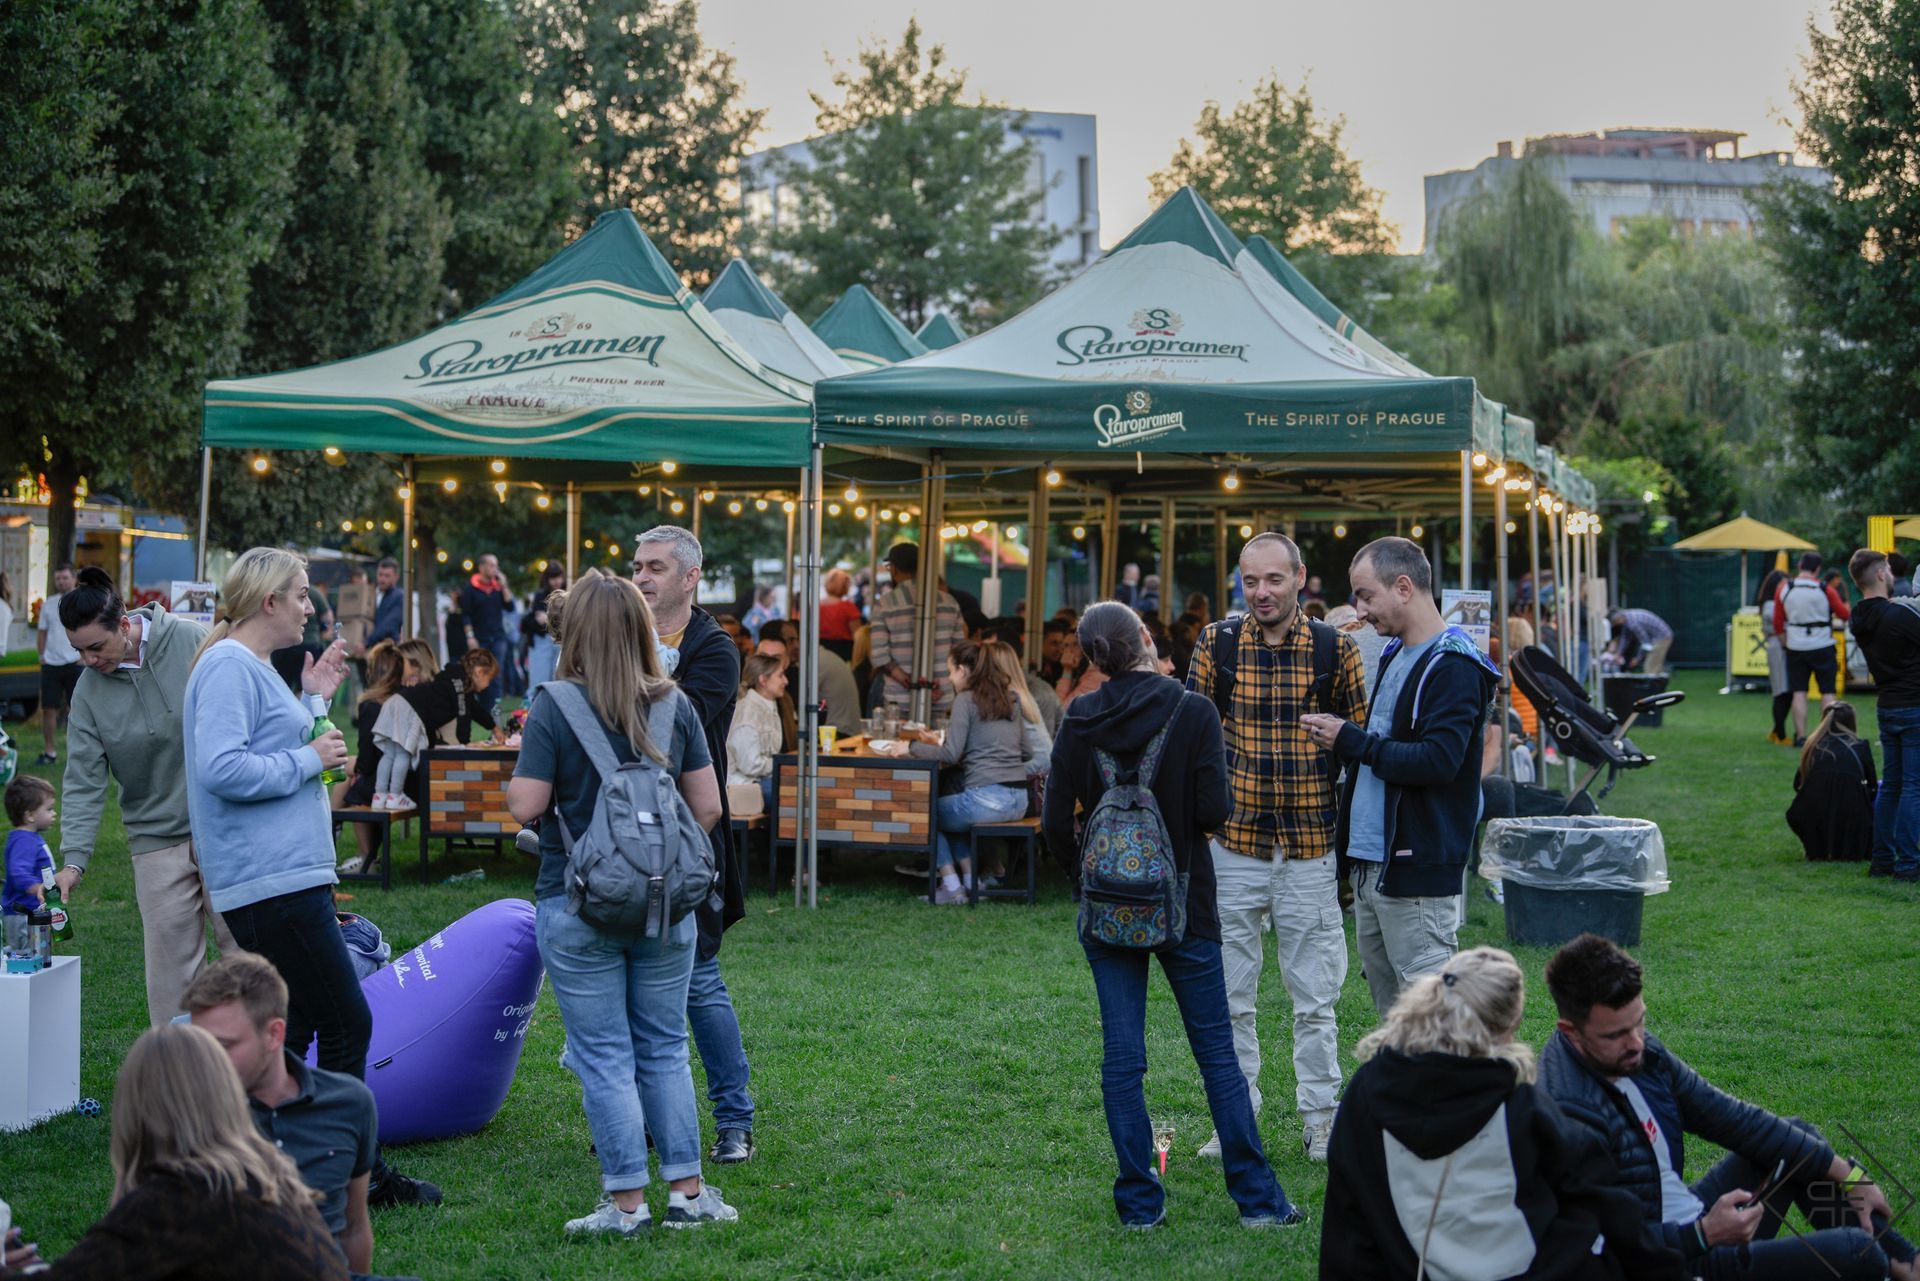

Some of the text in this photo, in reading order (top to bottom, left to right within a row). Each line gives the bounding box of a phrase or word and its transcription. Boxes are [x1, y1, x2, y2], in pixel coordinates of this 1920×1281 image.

[1056, 325, 1249, 366] Staropramen
[403, 334, 666, 381] Staropramen
[569, 376, 628, 385] PREMIUM
[834, 413, 1029, 426] THE SPIRIT OF PRAGUE
[1093, 404, 1187, 447] Staropramen
[1245, 412, 1446, 426] THE SPIRIT OF PRAGUE
[494, 1029, 510, 1042] by
